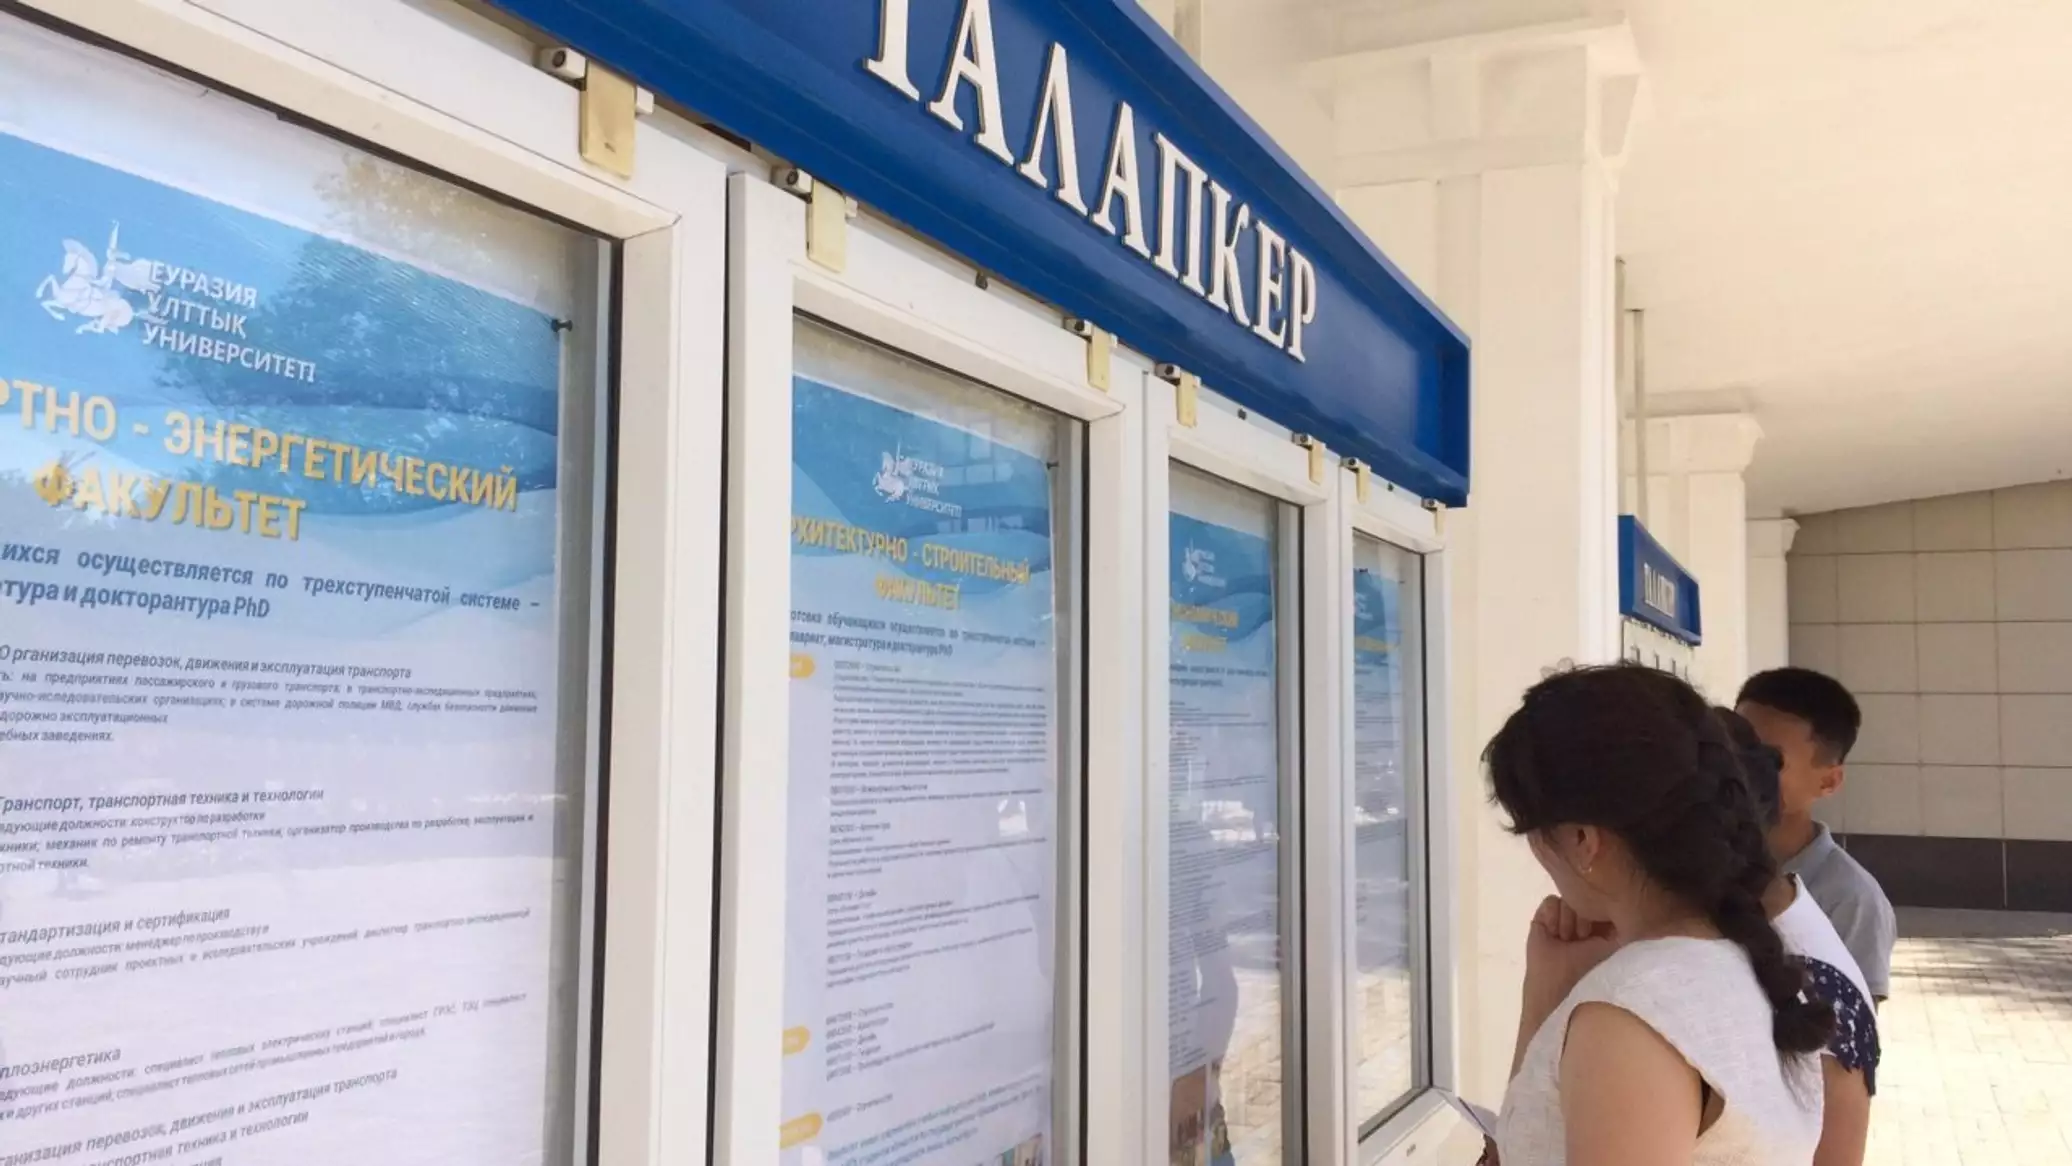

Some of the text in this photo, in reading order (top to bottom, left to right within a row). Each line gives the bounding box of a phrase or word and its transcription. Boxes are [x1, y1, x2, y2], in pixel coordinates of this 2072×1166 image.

[151, 260, 257, 308] ЕУРАЗИЯ
[132, 425, 149, 436] -
[164, 411, 518, 512] ЭНЕРГЕТИЧЕСКИЙ
[33, 457, 307, 541] ФАКУЛЬТЕТ
[922, 543, 1033, 585] СТРОИТЕЛЬНЫЙ
[77, 551, 254, 586] осуществляется
[265, 571, 289, 589] по
[303, 574, 451, 605] трехступенчатой
[460, 591, 521, 611] системе
[0, 578, 271, 620] тура и докторантура PhD
[22, 671, 37, 683] на
[44, 671, 128, 687] предприятиях
[106, 652, 183, 672] перевозок,
[184, 656, 249, 673] движения
[250, 660, 259, 672] и
[259, 661, 345, 680] эксплуатация
[347, 663, 412, 681] транспорта
[88, 793, 187, 811] транспортная
[190, 791, 239, 804] техника
[241, 792, 249, 802] и
[253, 789, 324, 803] технологии
[102, 837, 117, 848] по
[123, 919, 134, 931] и
[136, 908, 231, 934] сертификация
[54, 962, 119, 981] сотрудник
[333, 1069, 398, 1095] транспорта
